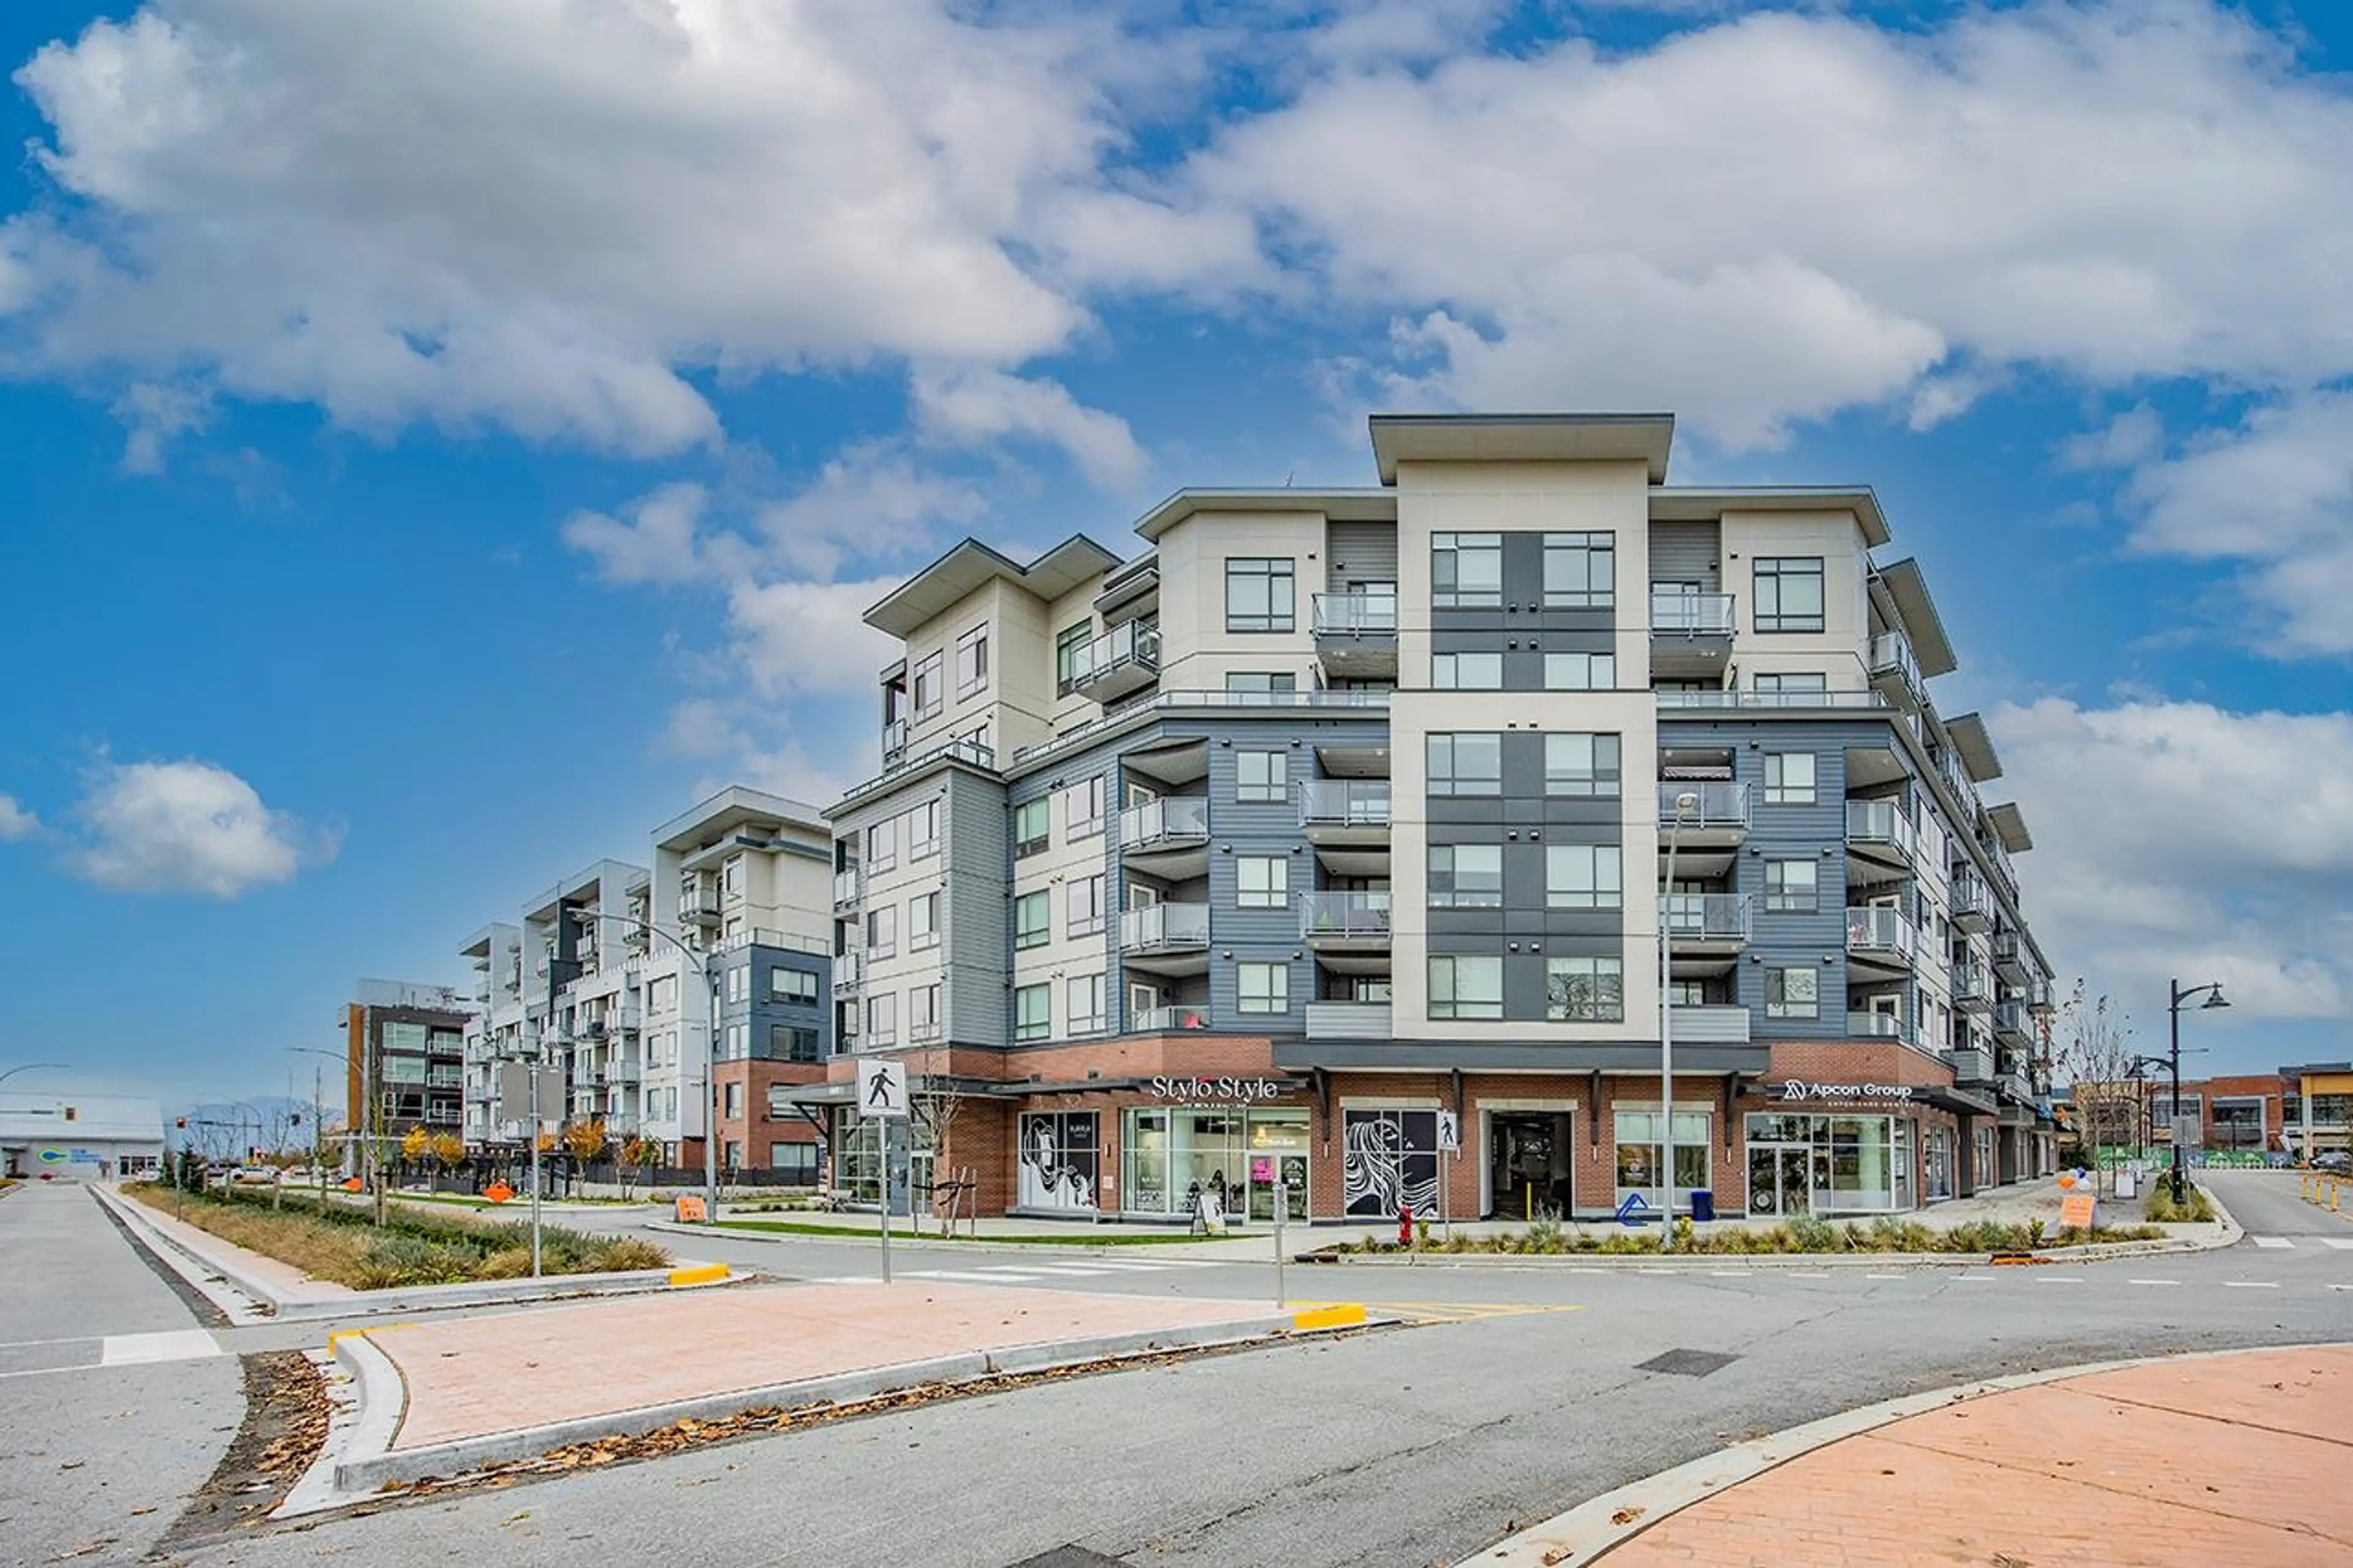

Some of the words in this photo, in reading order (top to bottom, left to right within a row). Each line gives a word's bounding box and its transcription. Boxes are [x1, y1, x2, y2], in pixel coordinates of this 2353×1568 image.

[1151, 1075, 1212, 1102] Stylo
[1218, 1076, 1278, 1103] Style
[1810, 1083, 1860, 1097] Apcon
[1864, 1083, 1912, 1099] Group
